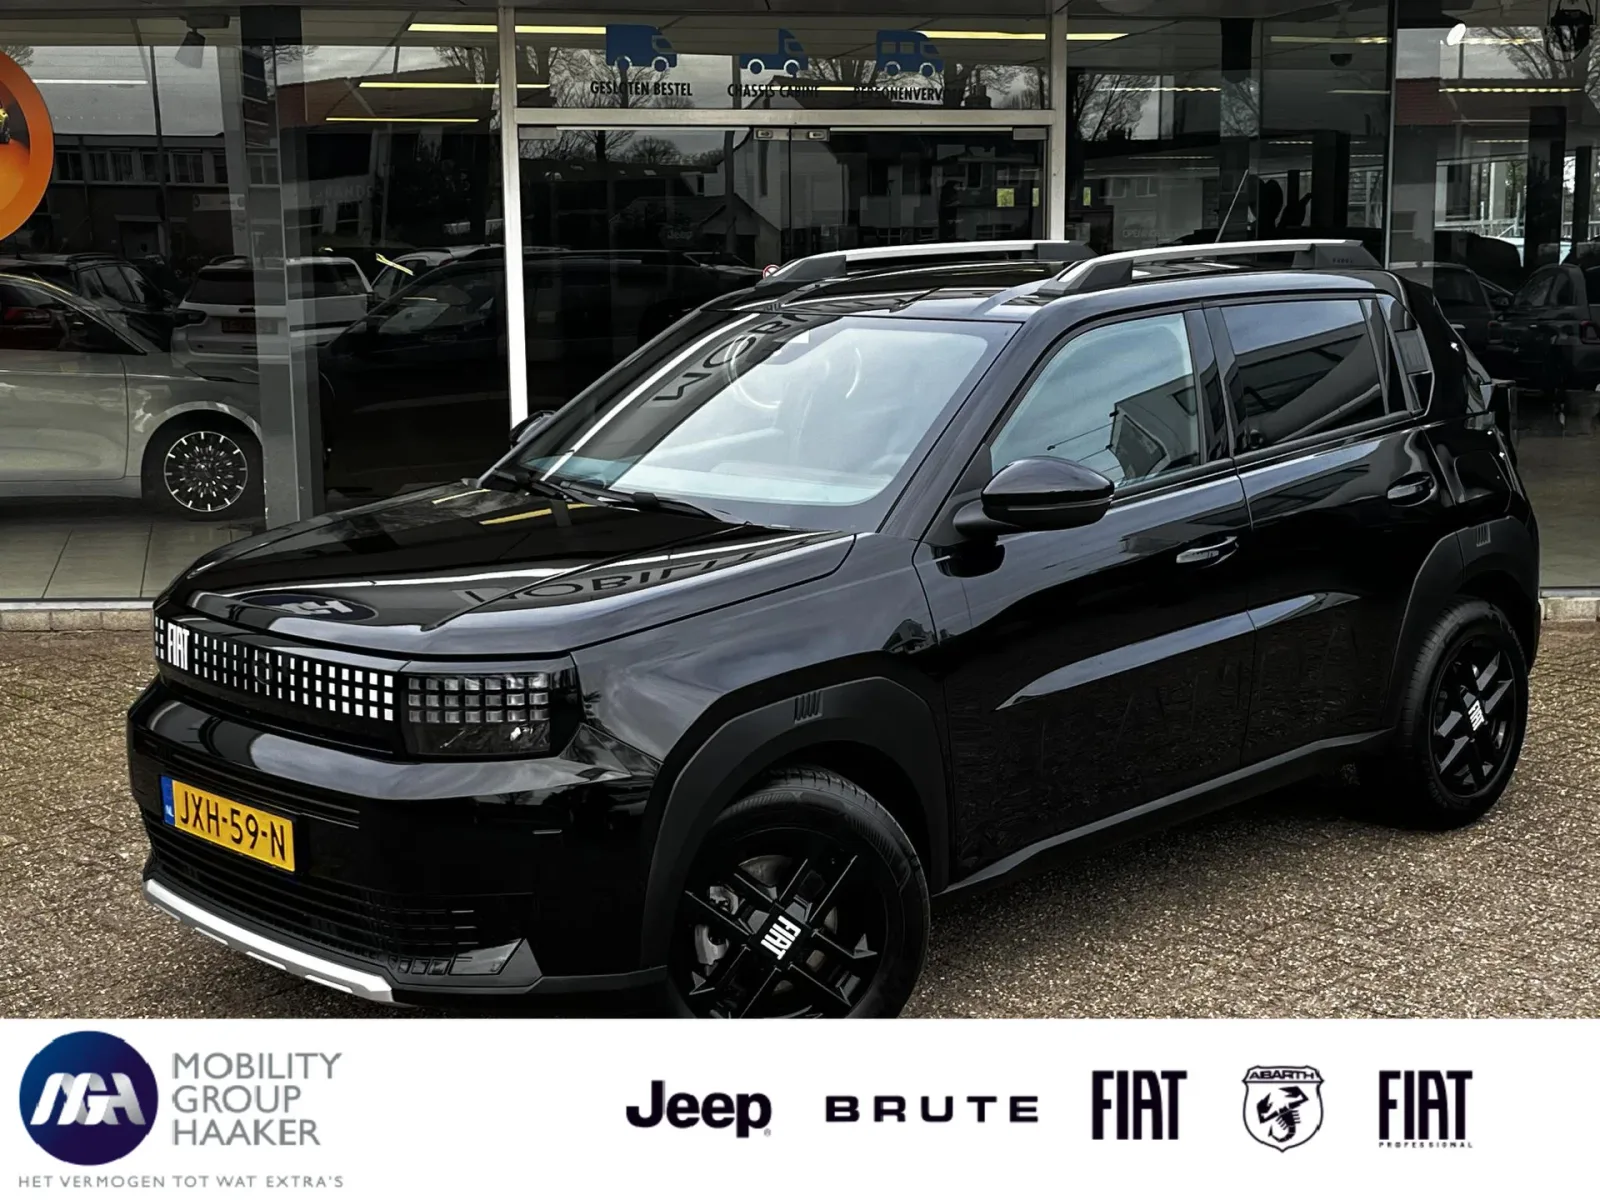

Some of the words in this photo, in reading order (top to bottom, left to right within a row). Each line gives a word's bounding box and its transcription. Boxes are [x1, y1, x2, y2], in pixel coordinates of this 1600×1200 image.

[590, 81, 649, 96] GESLOTEN
[653, 82, 693, 97] BESTEL
[727, 83, 775, 98] CHASSIS
[168, 622, 190, 671] FIAT
[1467, 699, 1485, 731] FIAT
[180, 790, 286, 862] JXH-59-N
[760, 915, 802, 960] FIAT
